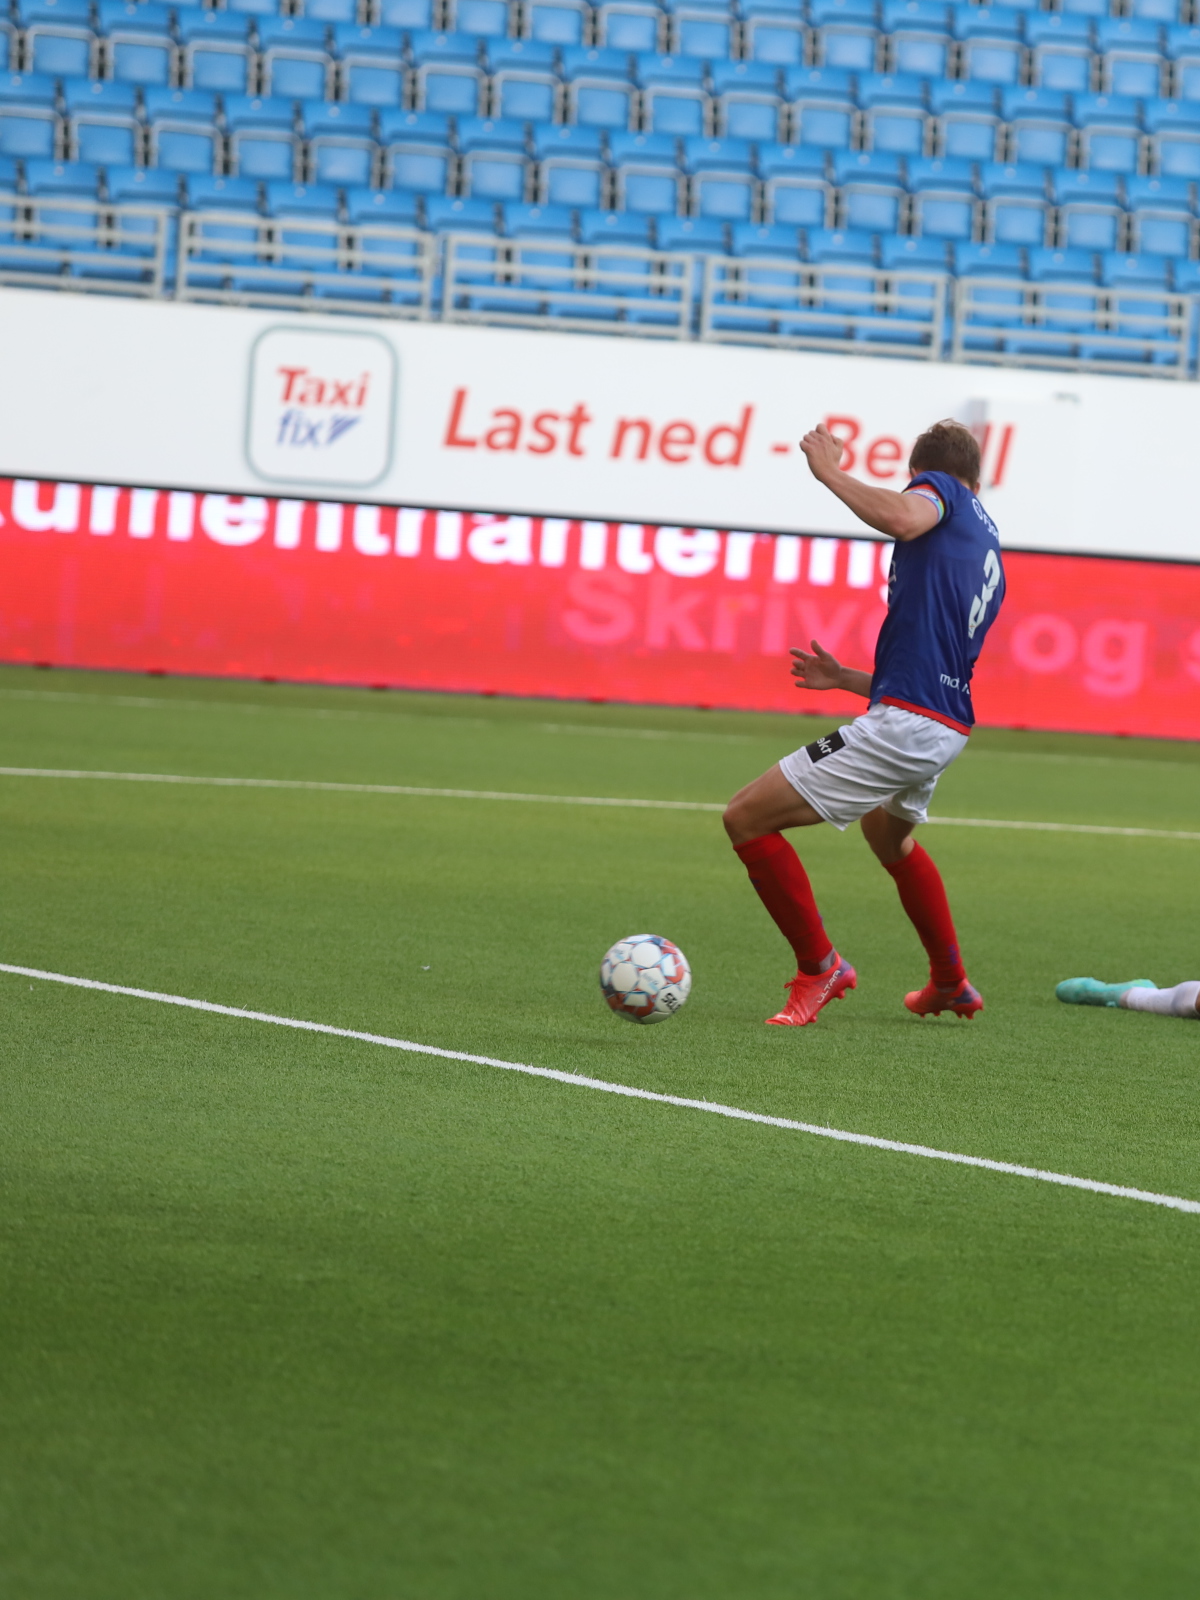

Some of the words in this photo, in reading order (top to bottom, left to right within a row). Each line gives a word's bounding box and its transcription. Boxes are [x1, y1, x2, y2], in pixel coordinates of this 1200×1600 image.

[277, 366, 370, 408] Taxi
[277, 409, 323, 448] fix
[442, 386, 592, 457] Last
[610, 403, 755, 468] ned
[1010, 612, 1148, 699] og
[816, 969, 842, 1004] ULTRA
